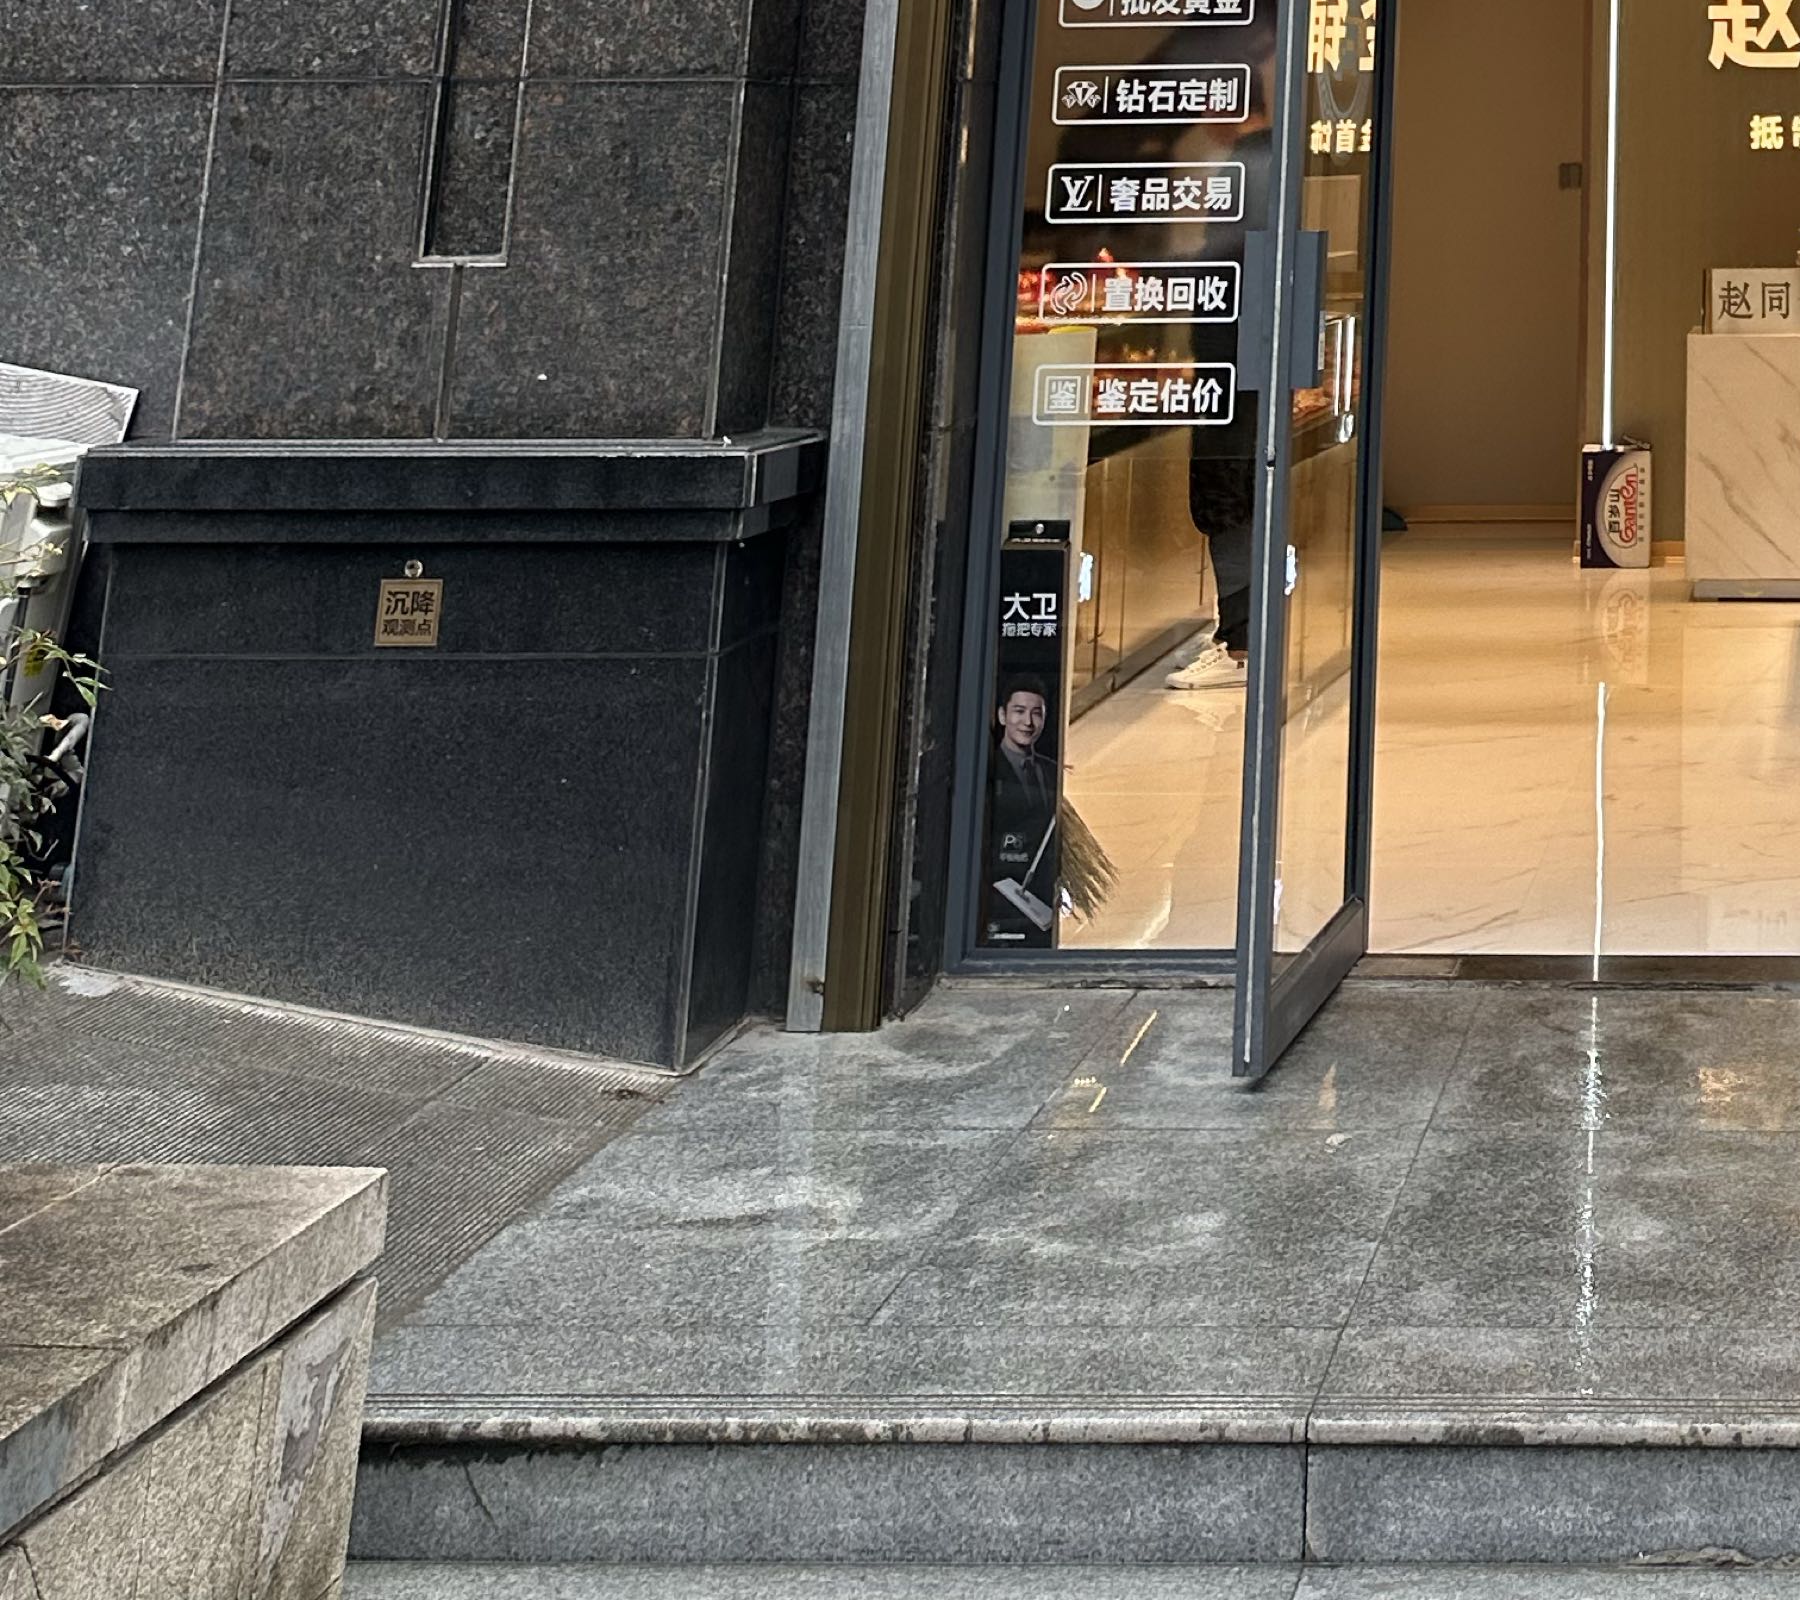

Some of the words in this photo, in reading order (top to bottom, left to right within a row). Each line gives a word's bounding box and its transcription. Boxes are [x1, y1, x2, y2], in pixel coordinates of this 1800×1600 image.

[1114, 77, 1239, 114] 钻石定制
[1109, 175, 1234, 213] 奢品交易
[1101, 275, 1230, 313] 置换回收
[1096, 377, 1224, 416] 鉴定估价
[384, 589, 436, 617] 沉降
[1002, 591, 1058, 621] 大卫
